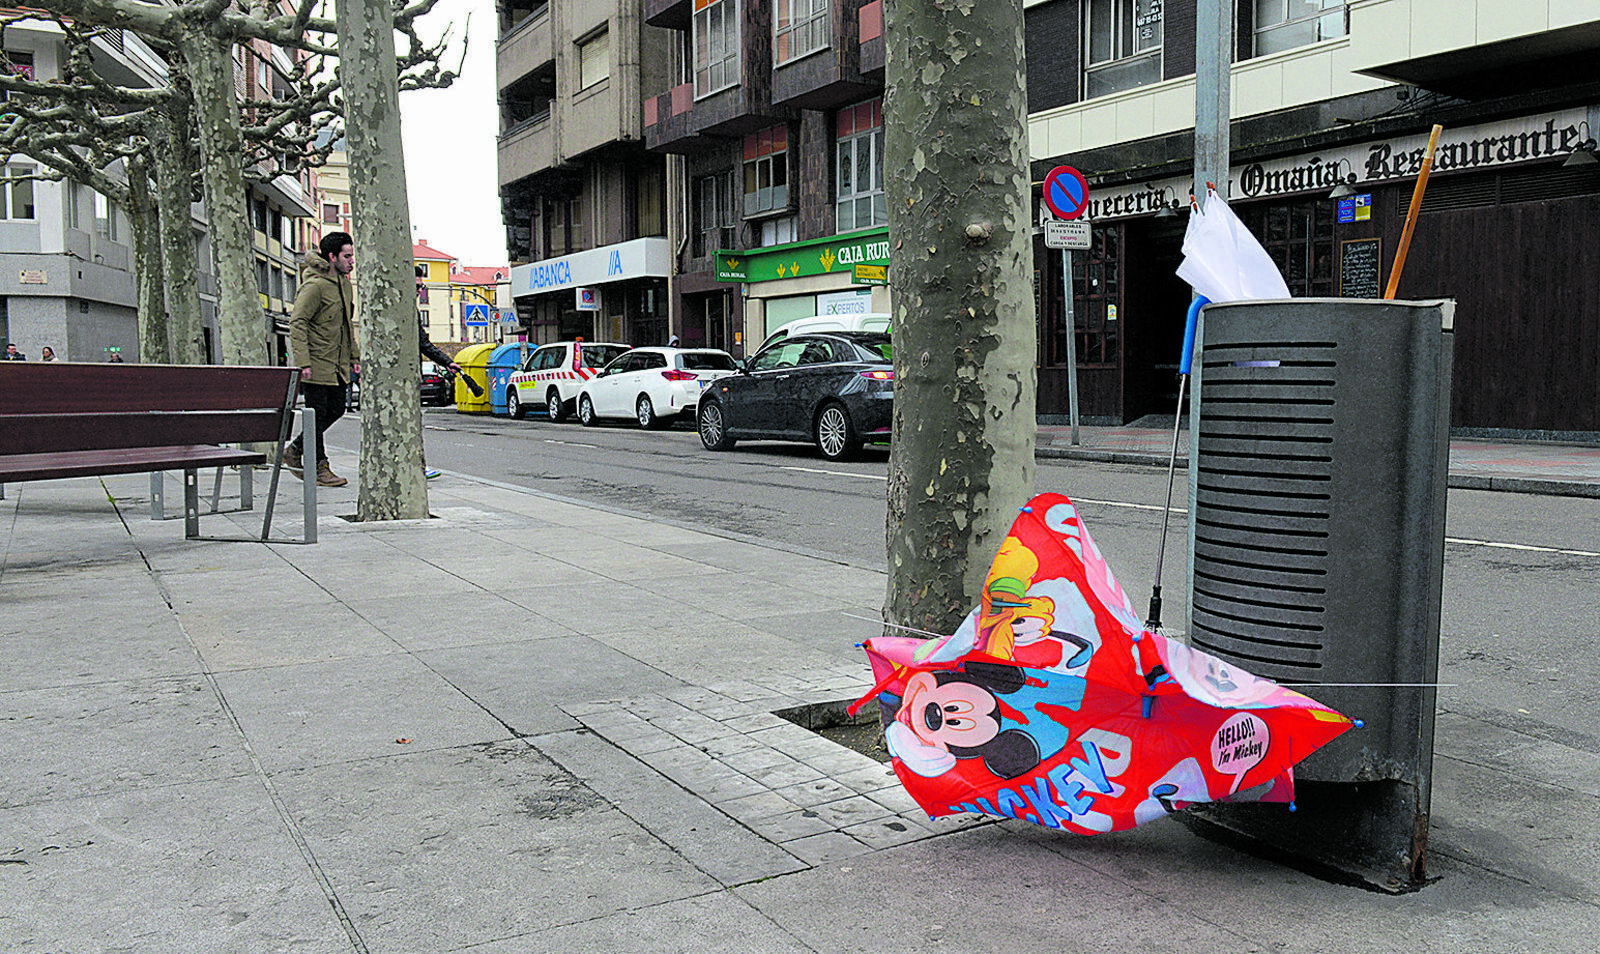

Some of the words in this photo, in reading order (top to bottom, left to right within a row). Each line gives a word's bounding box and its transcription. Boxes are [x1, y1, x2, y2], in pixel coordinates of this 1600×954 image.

[1240, 156, 1343, 198] Omaña
[837, 244, 864, 264] CAJA
[866, 240, 890, 262] RUR
[1218, 717, 1256, 750] HELLO!!
[1232, 740, 1263, 761] Mickey
[948, 740, 1114, 829] ICKEY
